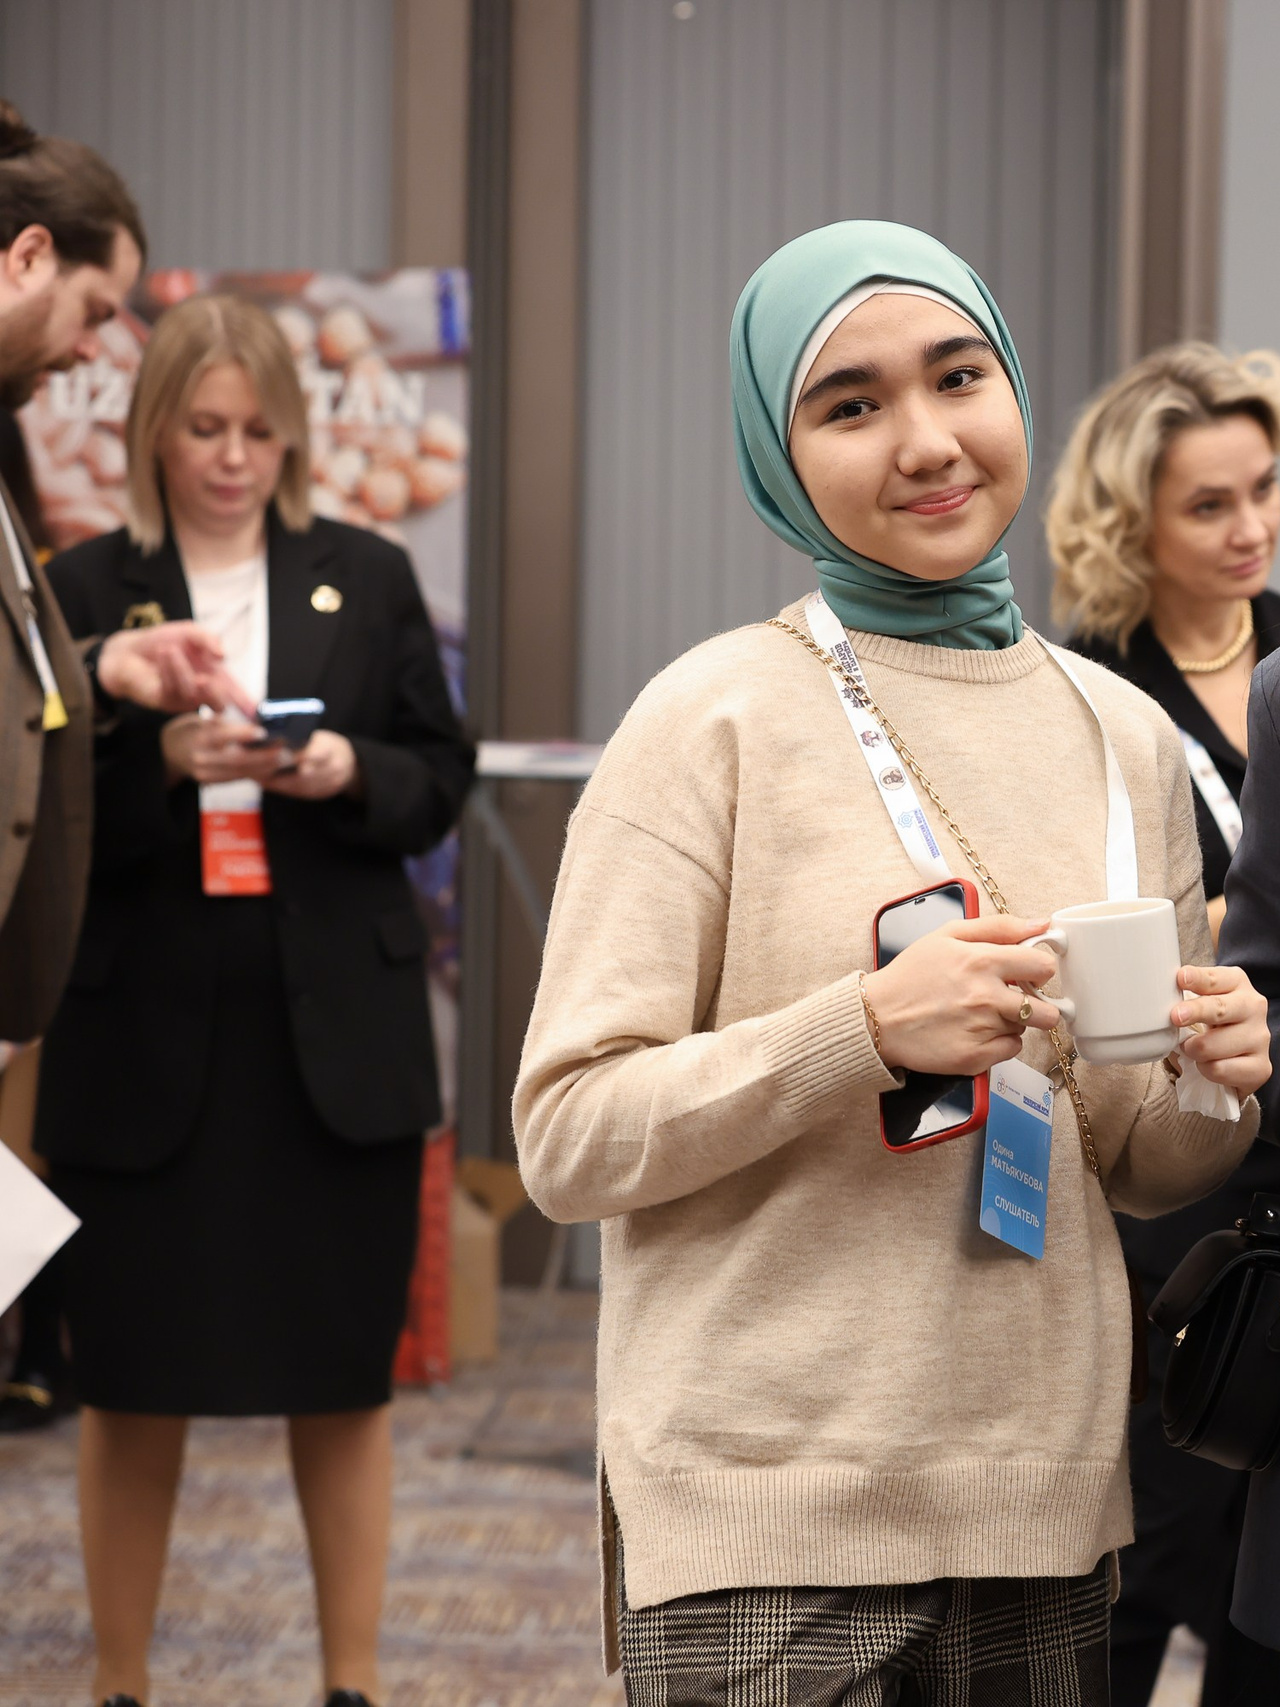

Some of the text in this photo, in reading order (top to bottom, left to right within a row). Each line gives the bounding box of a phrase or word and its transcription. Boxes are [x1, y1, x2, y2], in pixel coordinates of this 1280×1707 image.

[50, 371, 426, 423] UZTAN
[992, 1139, 1014, 1160] Одина
[991, 1155, 1044, 1193] МАТЬЯКУБОВА
[994, 1195, 1040, 1228] СЛУШАТЕЛЬ
